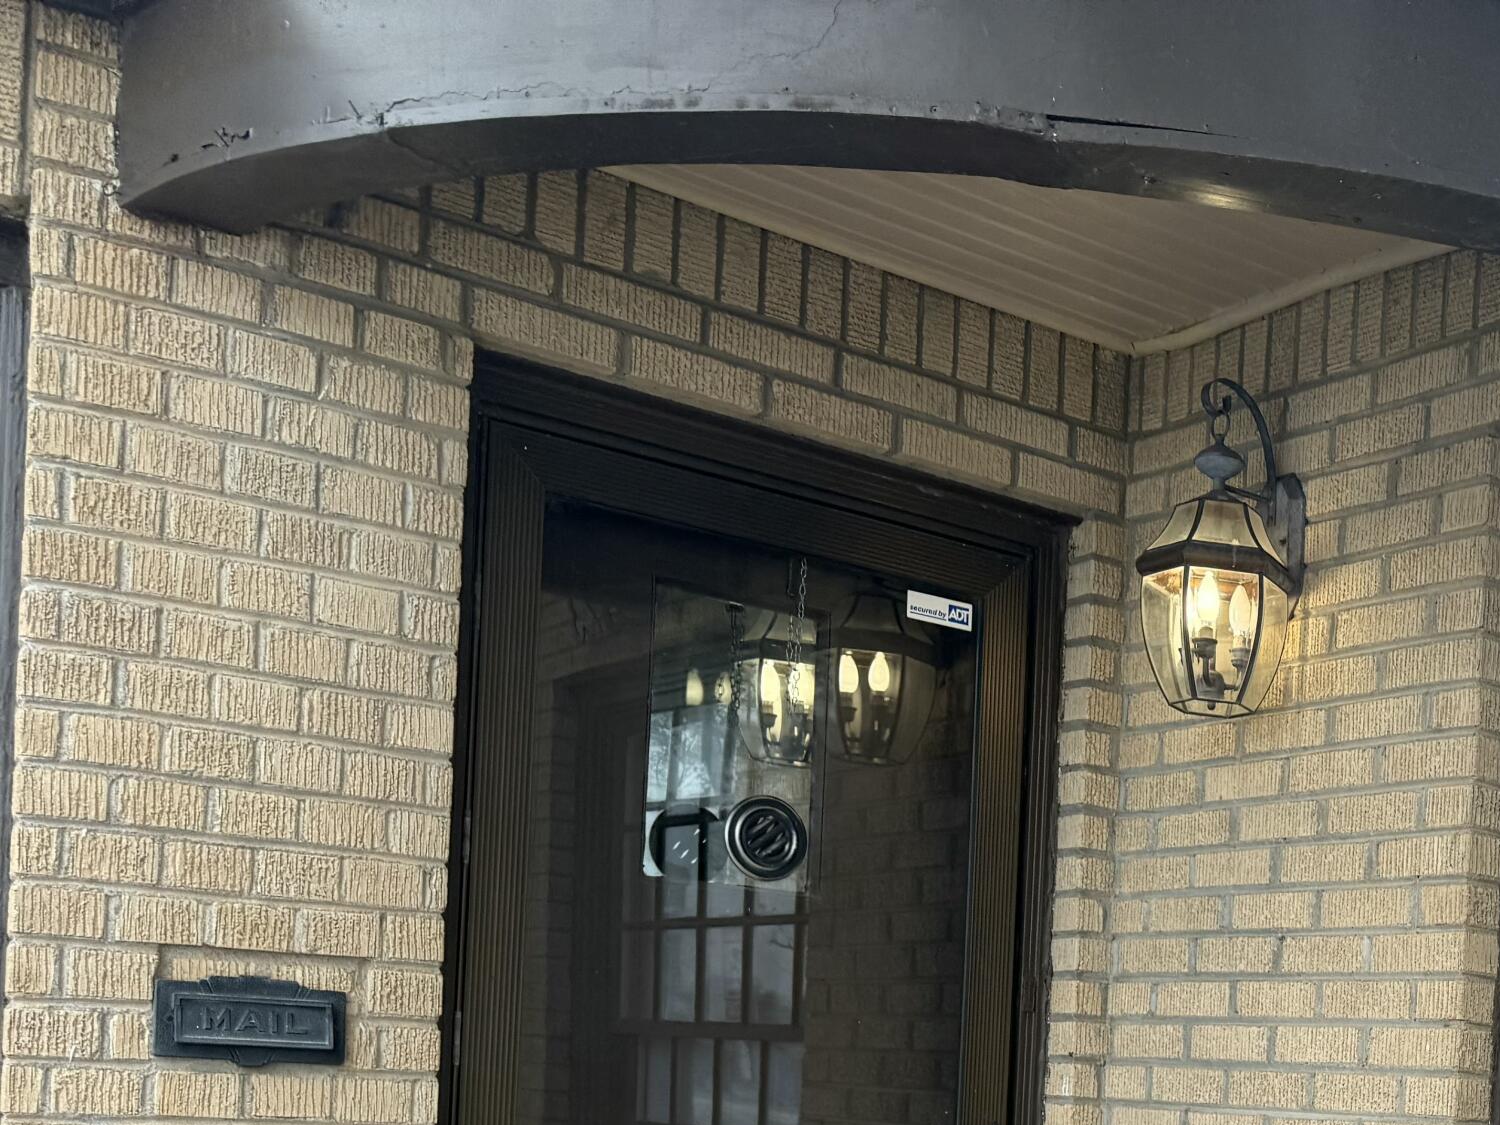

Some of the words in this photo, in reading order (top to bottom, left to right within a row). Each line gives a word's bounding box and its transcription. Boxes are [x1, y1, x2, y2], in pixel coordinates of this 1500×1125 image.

[910, 604, 937, 615] secured
[938, 610, 947, 618] by
[948, 607, 969, 624] ADT
[202, 1007, 309, 1035] MAIL
